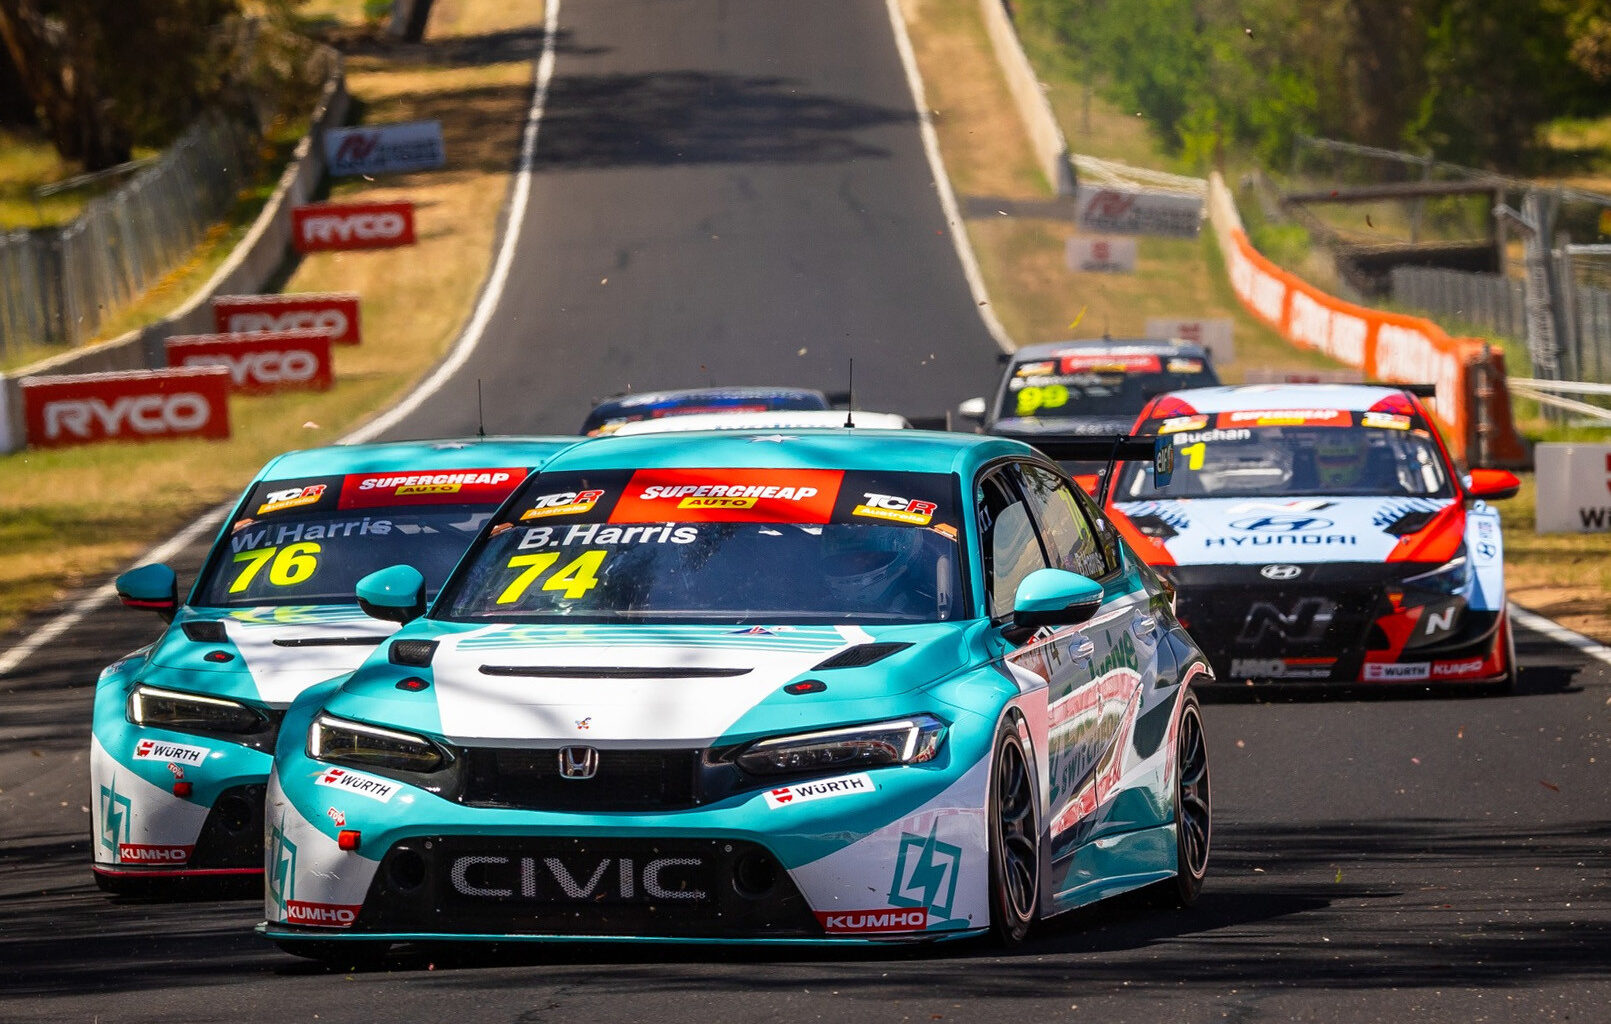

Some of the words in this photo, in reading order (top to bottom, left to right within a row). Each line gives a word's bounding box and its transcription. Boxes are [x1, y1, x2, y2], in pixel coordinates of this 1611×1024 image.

[303, 212, 406, 243] RYCO
[43, 392, 211, 439] RYCO
[1173, 429, 1250, 445] Buchan
[1180, 443, 1206, 471] 1
[359, 472, 510, 490] SUPERCHEAP
[401, 485, 453, 493] AUTO
[266, 484, 328, 505] TCR
[534, 489, 606, 509] TCR
[639, 485, 818, 501] SUPERCHEAP
[528, 504, 589, 517] Australia
[688, 499, 748, 507] AUTO
[863, 492, 938, 517] TCR
[860, 506, 925, 523] Australia
[231, 516, 392, 553] W.Harris
[517, 522, 698, 550] B.Harris
[1205, 534, 1356, 547] HYUNDAI
[228, 541, 321, 594] 76
[496, 550, 608, 604] 74
[1425, 606, 1456, 636] N
[153, 745, 200, 761] WÜRTH
[340, 774, 391, 797] WÜRTH
[796, 778, 864, 797] WÜRTH
[121, 846, 186, 861] KUMHO
[451, 856, 706, 898] CIVIC
[287, 905, 355, 922] KUMHO
[826, 912, 924, 928] KUMHO
